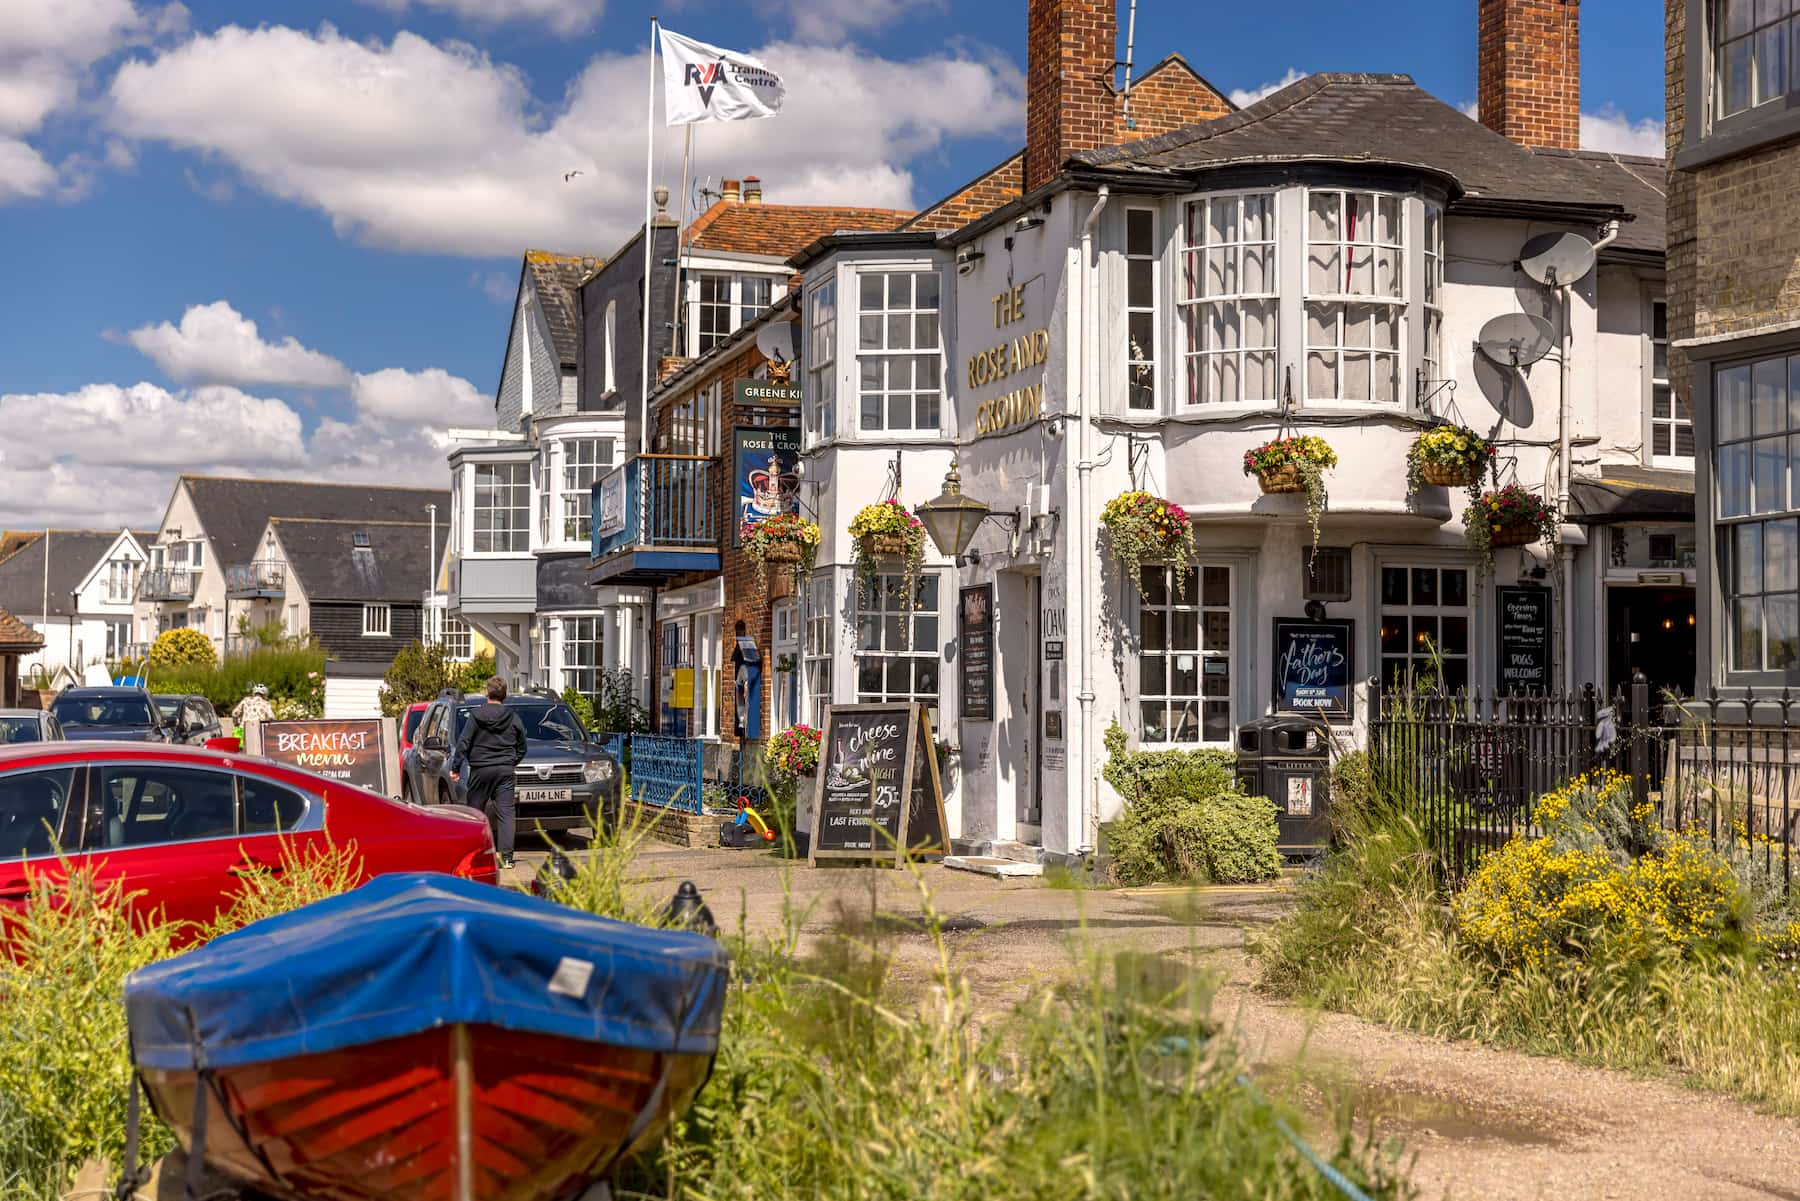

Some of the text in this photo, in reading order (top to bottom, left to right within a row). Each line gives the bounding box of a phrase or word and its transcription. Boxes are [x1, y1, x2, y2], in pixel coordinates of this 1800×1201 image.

[684, 62, 728, 87] RYA
[734, 74, 777, 88] Centre
[992, 283, 1025, 329] THE
[968, 328, 1049, 389] ROSE AND
[745, 387, 803, 399] GREENE KI
[975, 383, 1041, 434] CROWN
[768, 431, 788, 441] THE
[743, 440, 766, 449] ROSE
[1511, 653, 1534, 666] DOGS
[1504, 667, 1543, 680] WELCOME
[1292, 697, 1332, 708] BOOK NOW
[277, 731, 369, 752] BREAKFAST
[296, 752, 356, 767] menu
[871, 768, 896, 780] NIGHT
[525, 790, 567, 801] AU14 LNE
[829, 816, 847, 826] LAST
